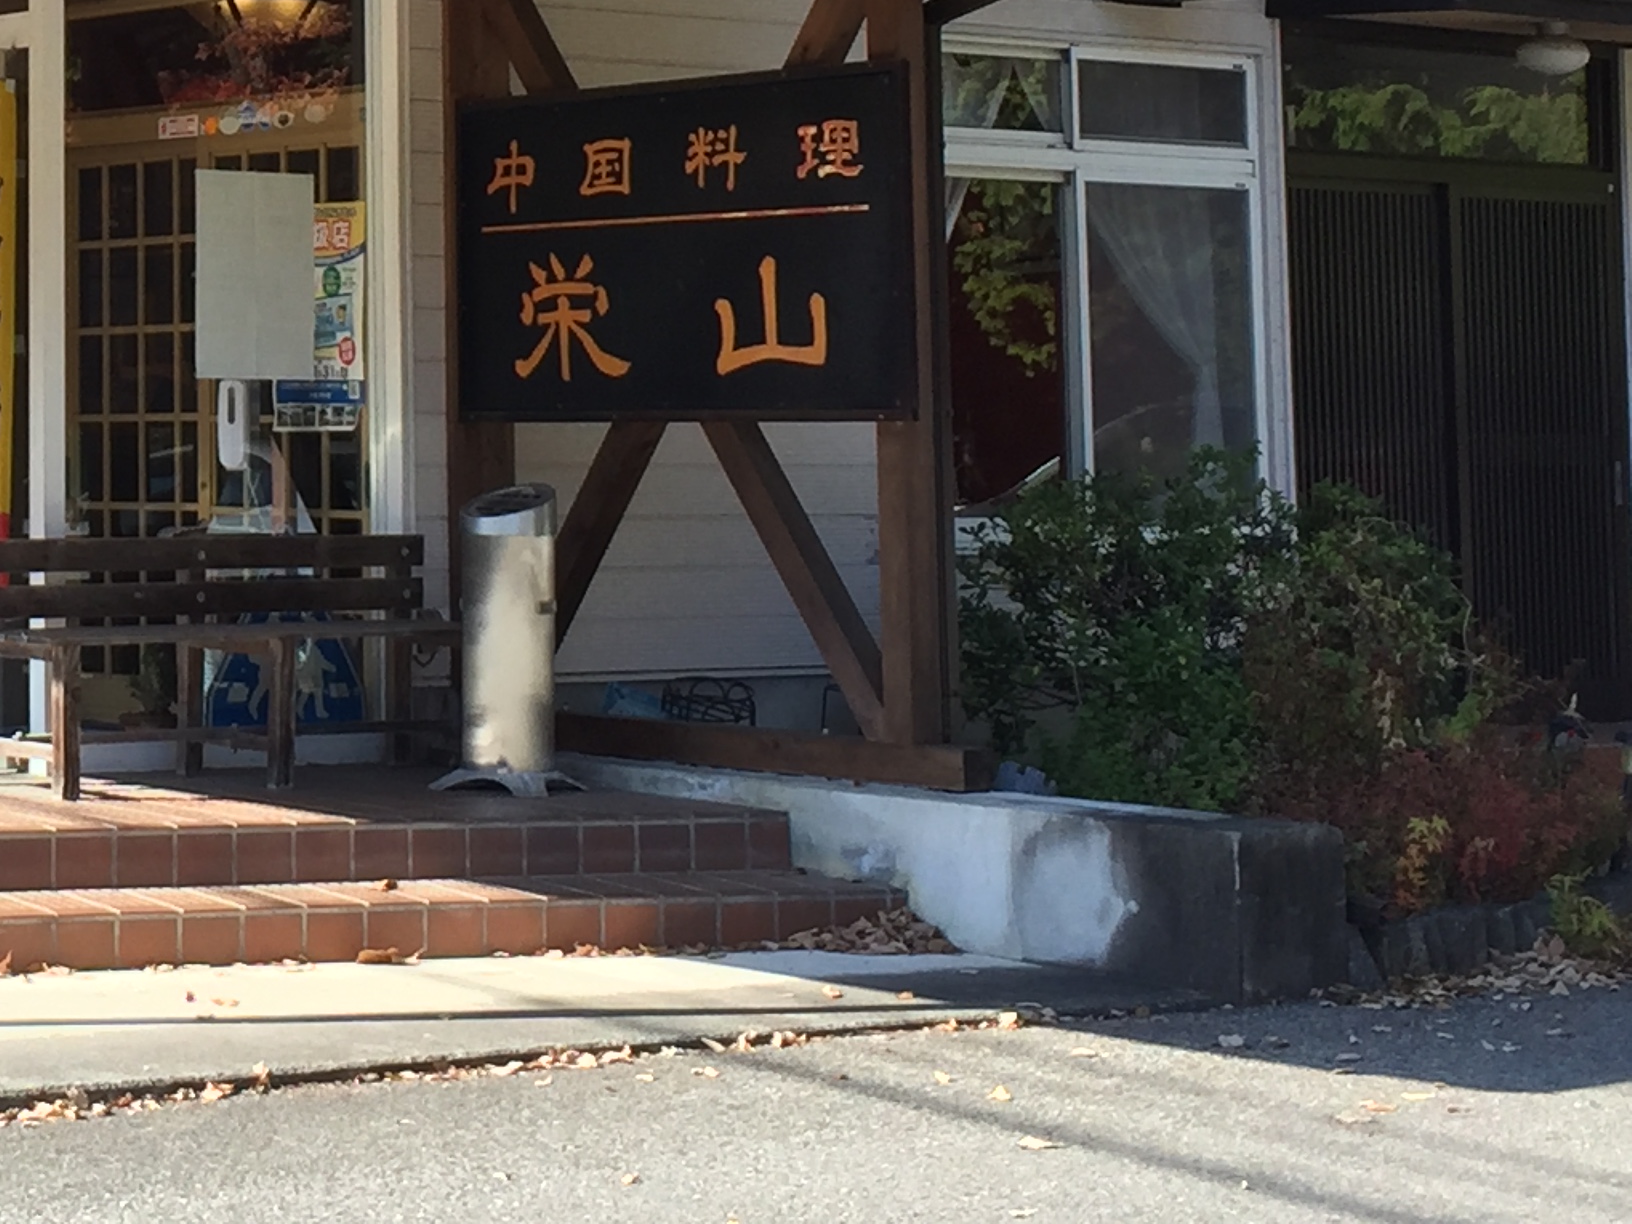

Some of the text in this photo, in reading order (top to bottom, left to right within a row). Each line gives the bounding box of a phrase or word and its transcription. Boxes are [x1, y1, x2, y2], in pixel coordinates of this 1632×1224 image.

[486, 118, 865, 214] 中国料理
[514, 252, 827, 381] 栄山
